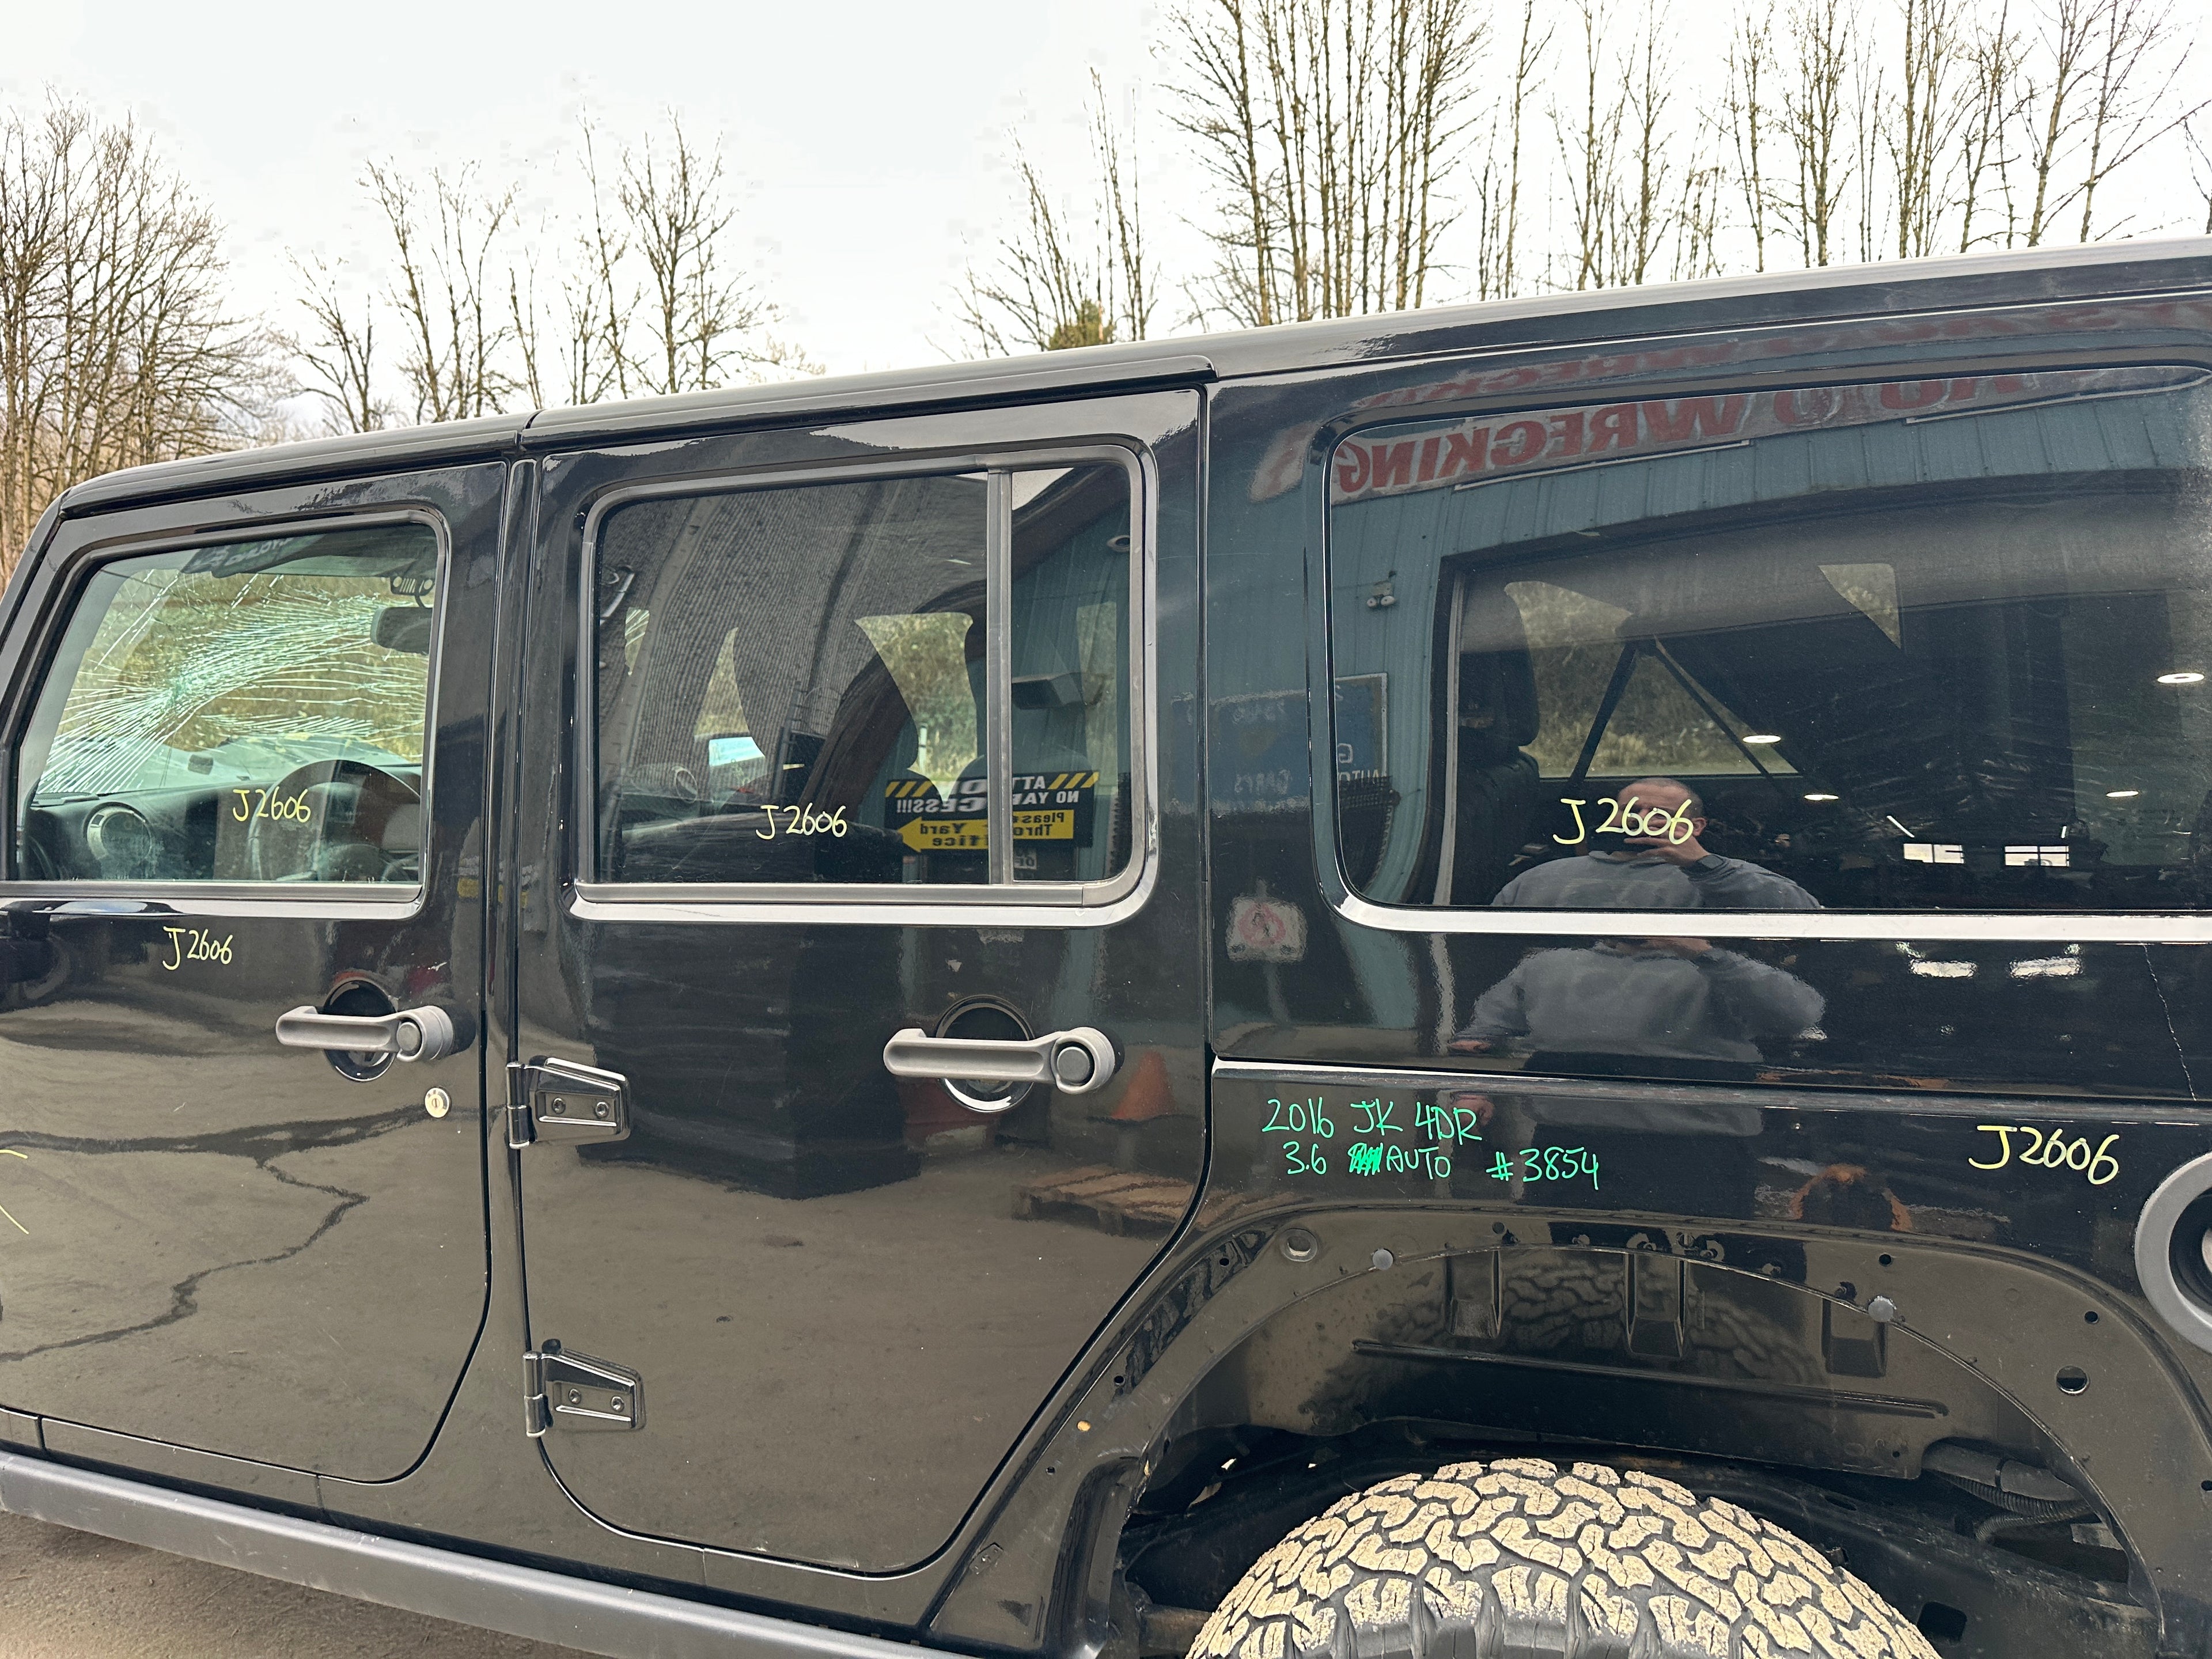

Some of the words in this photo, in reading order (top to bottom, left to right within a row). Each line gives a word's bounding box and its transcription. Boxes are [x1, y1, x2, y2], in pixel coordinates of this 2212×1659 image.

[232, 785, 310, 823] J2606
[755, 801, 848, 840] J2606
[1552, 796, 1694, 846] J2606
[162, 925, 233, 971] J2606
[1262, 1097, 1334, 1138] 2016
[1350, 1097, 1403, 1136] JK
[1414, 1101, 1483, 1146] 4DR
[1282, 1141, 1327, 1175] 3.6
[1386, 1146, 1451, 1180] AUTO
[1486, 1146, 1600, 1191] #3854
[1968, 1125, 2120, 1185] J2606
